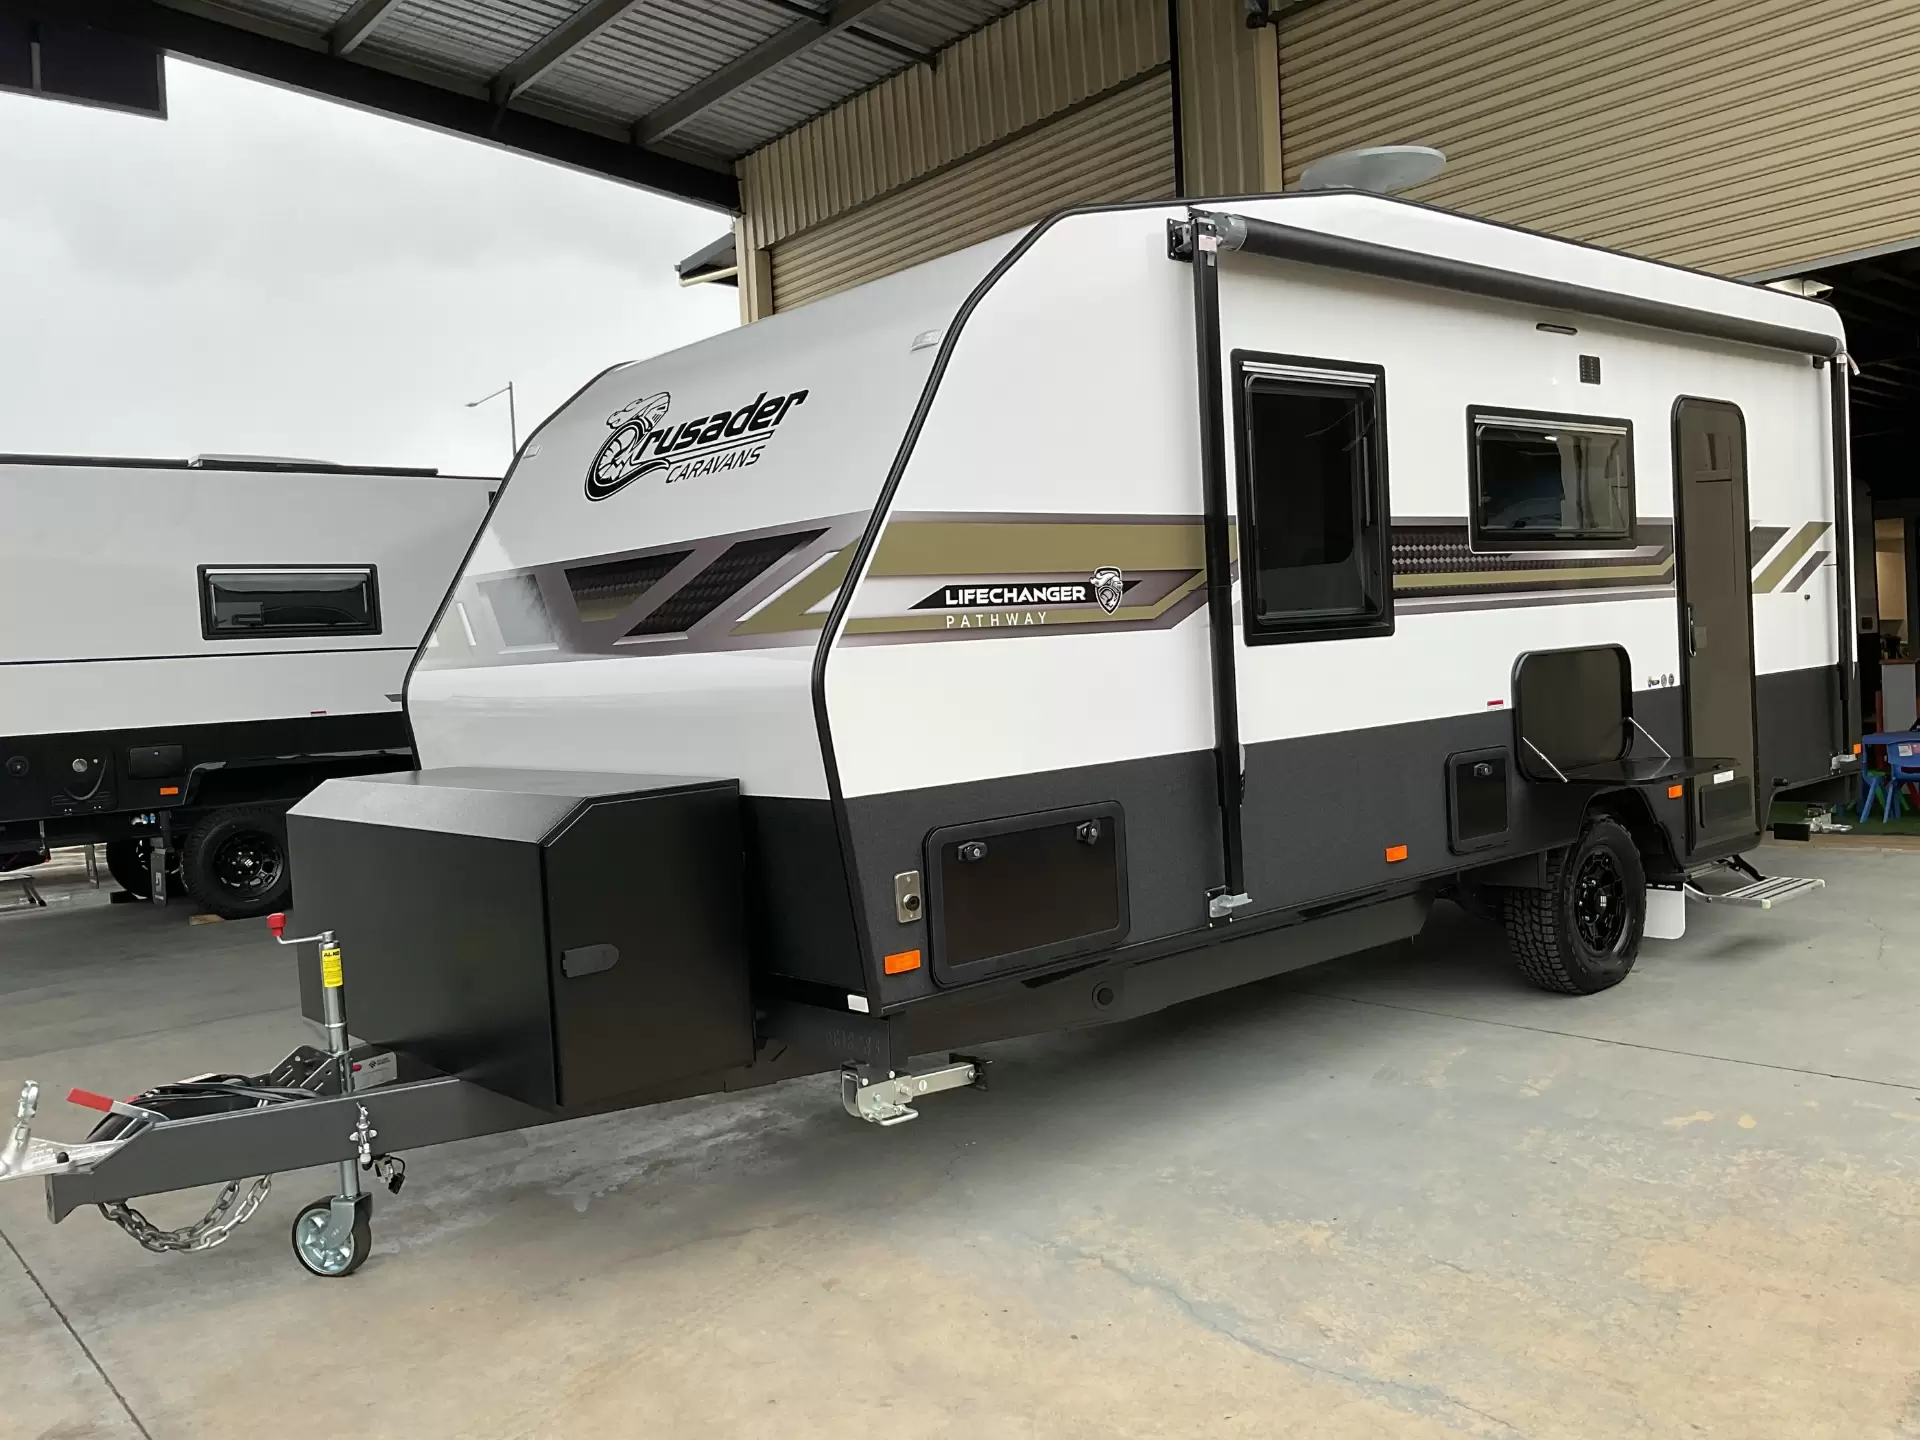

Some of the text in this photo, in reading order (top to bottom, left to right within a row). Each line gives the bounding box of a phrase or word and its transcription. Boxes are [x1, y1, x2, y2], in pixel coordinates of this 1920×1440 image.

[665, 445, 766, 483] CARAVANS
[945, 587, 1086, 605] LIFECHANGER
[946, 613, 1046, 628] PATHWAY
